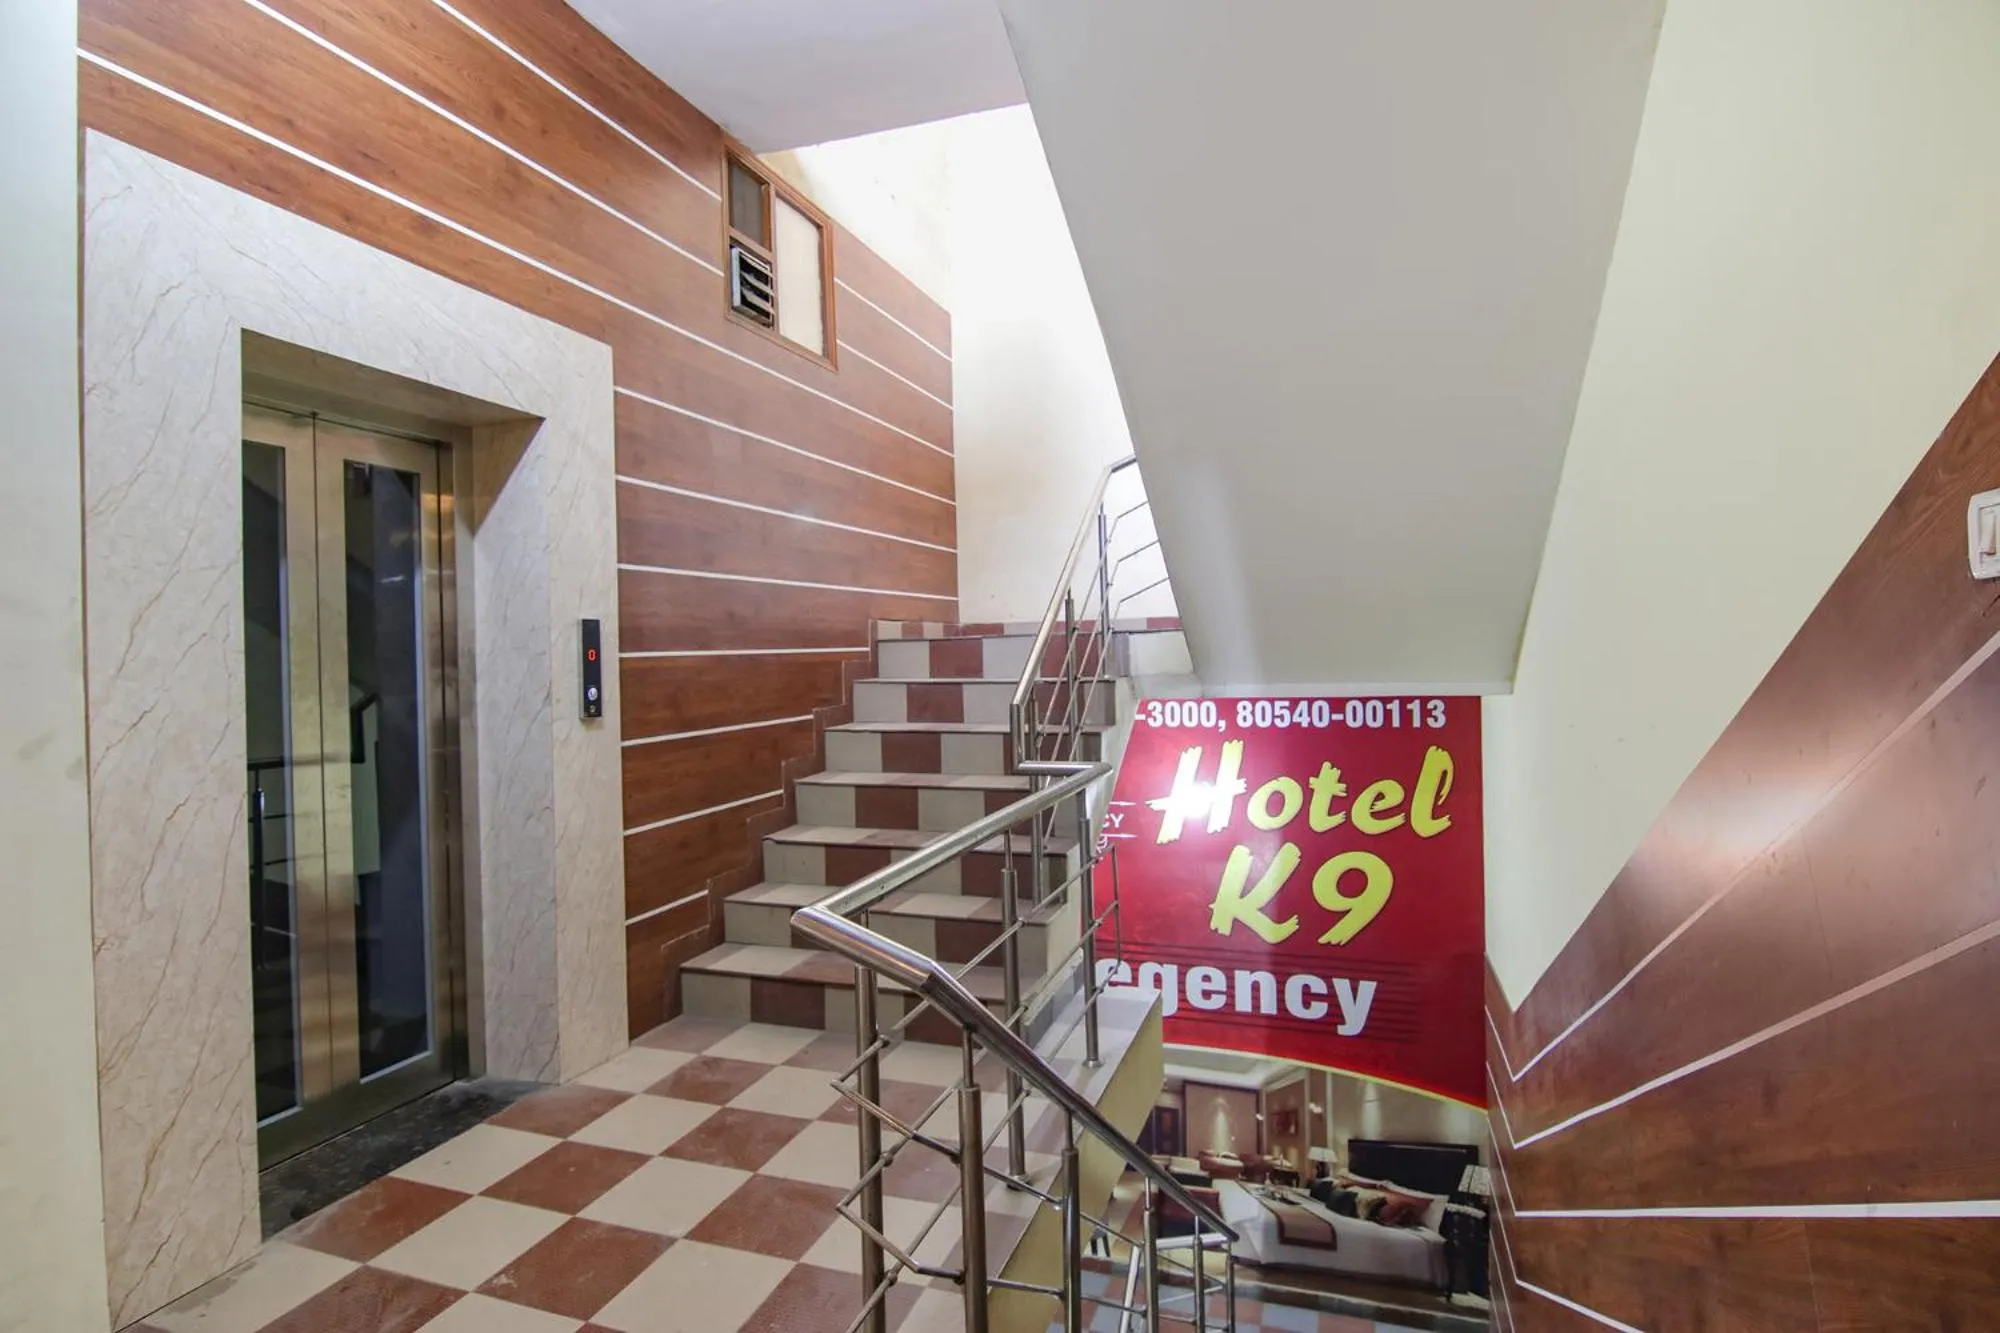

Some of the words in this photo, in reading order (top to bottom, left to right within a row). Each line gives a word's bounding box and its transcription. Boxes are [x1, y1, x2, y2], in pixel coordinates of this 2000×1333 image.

[587, 649, 596, 661] 0
[1237, 699, 1446, 728] 80540-00113
[1146, 739, 1454, 844] Hotel
[1208, 842, 1394, 946] K9
